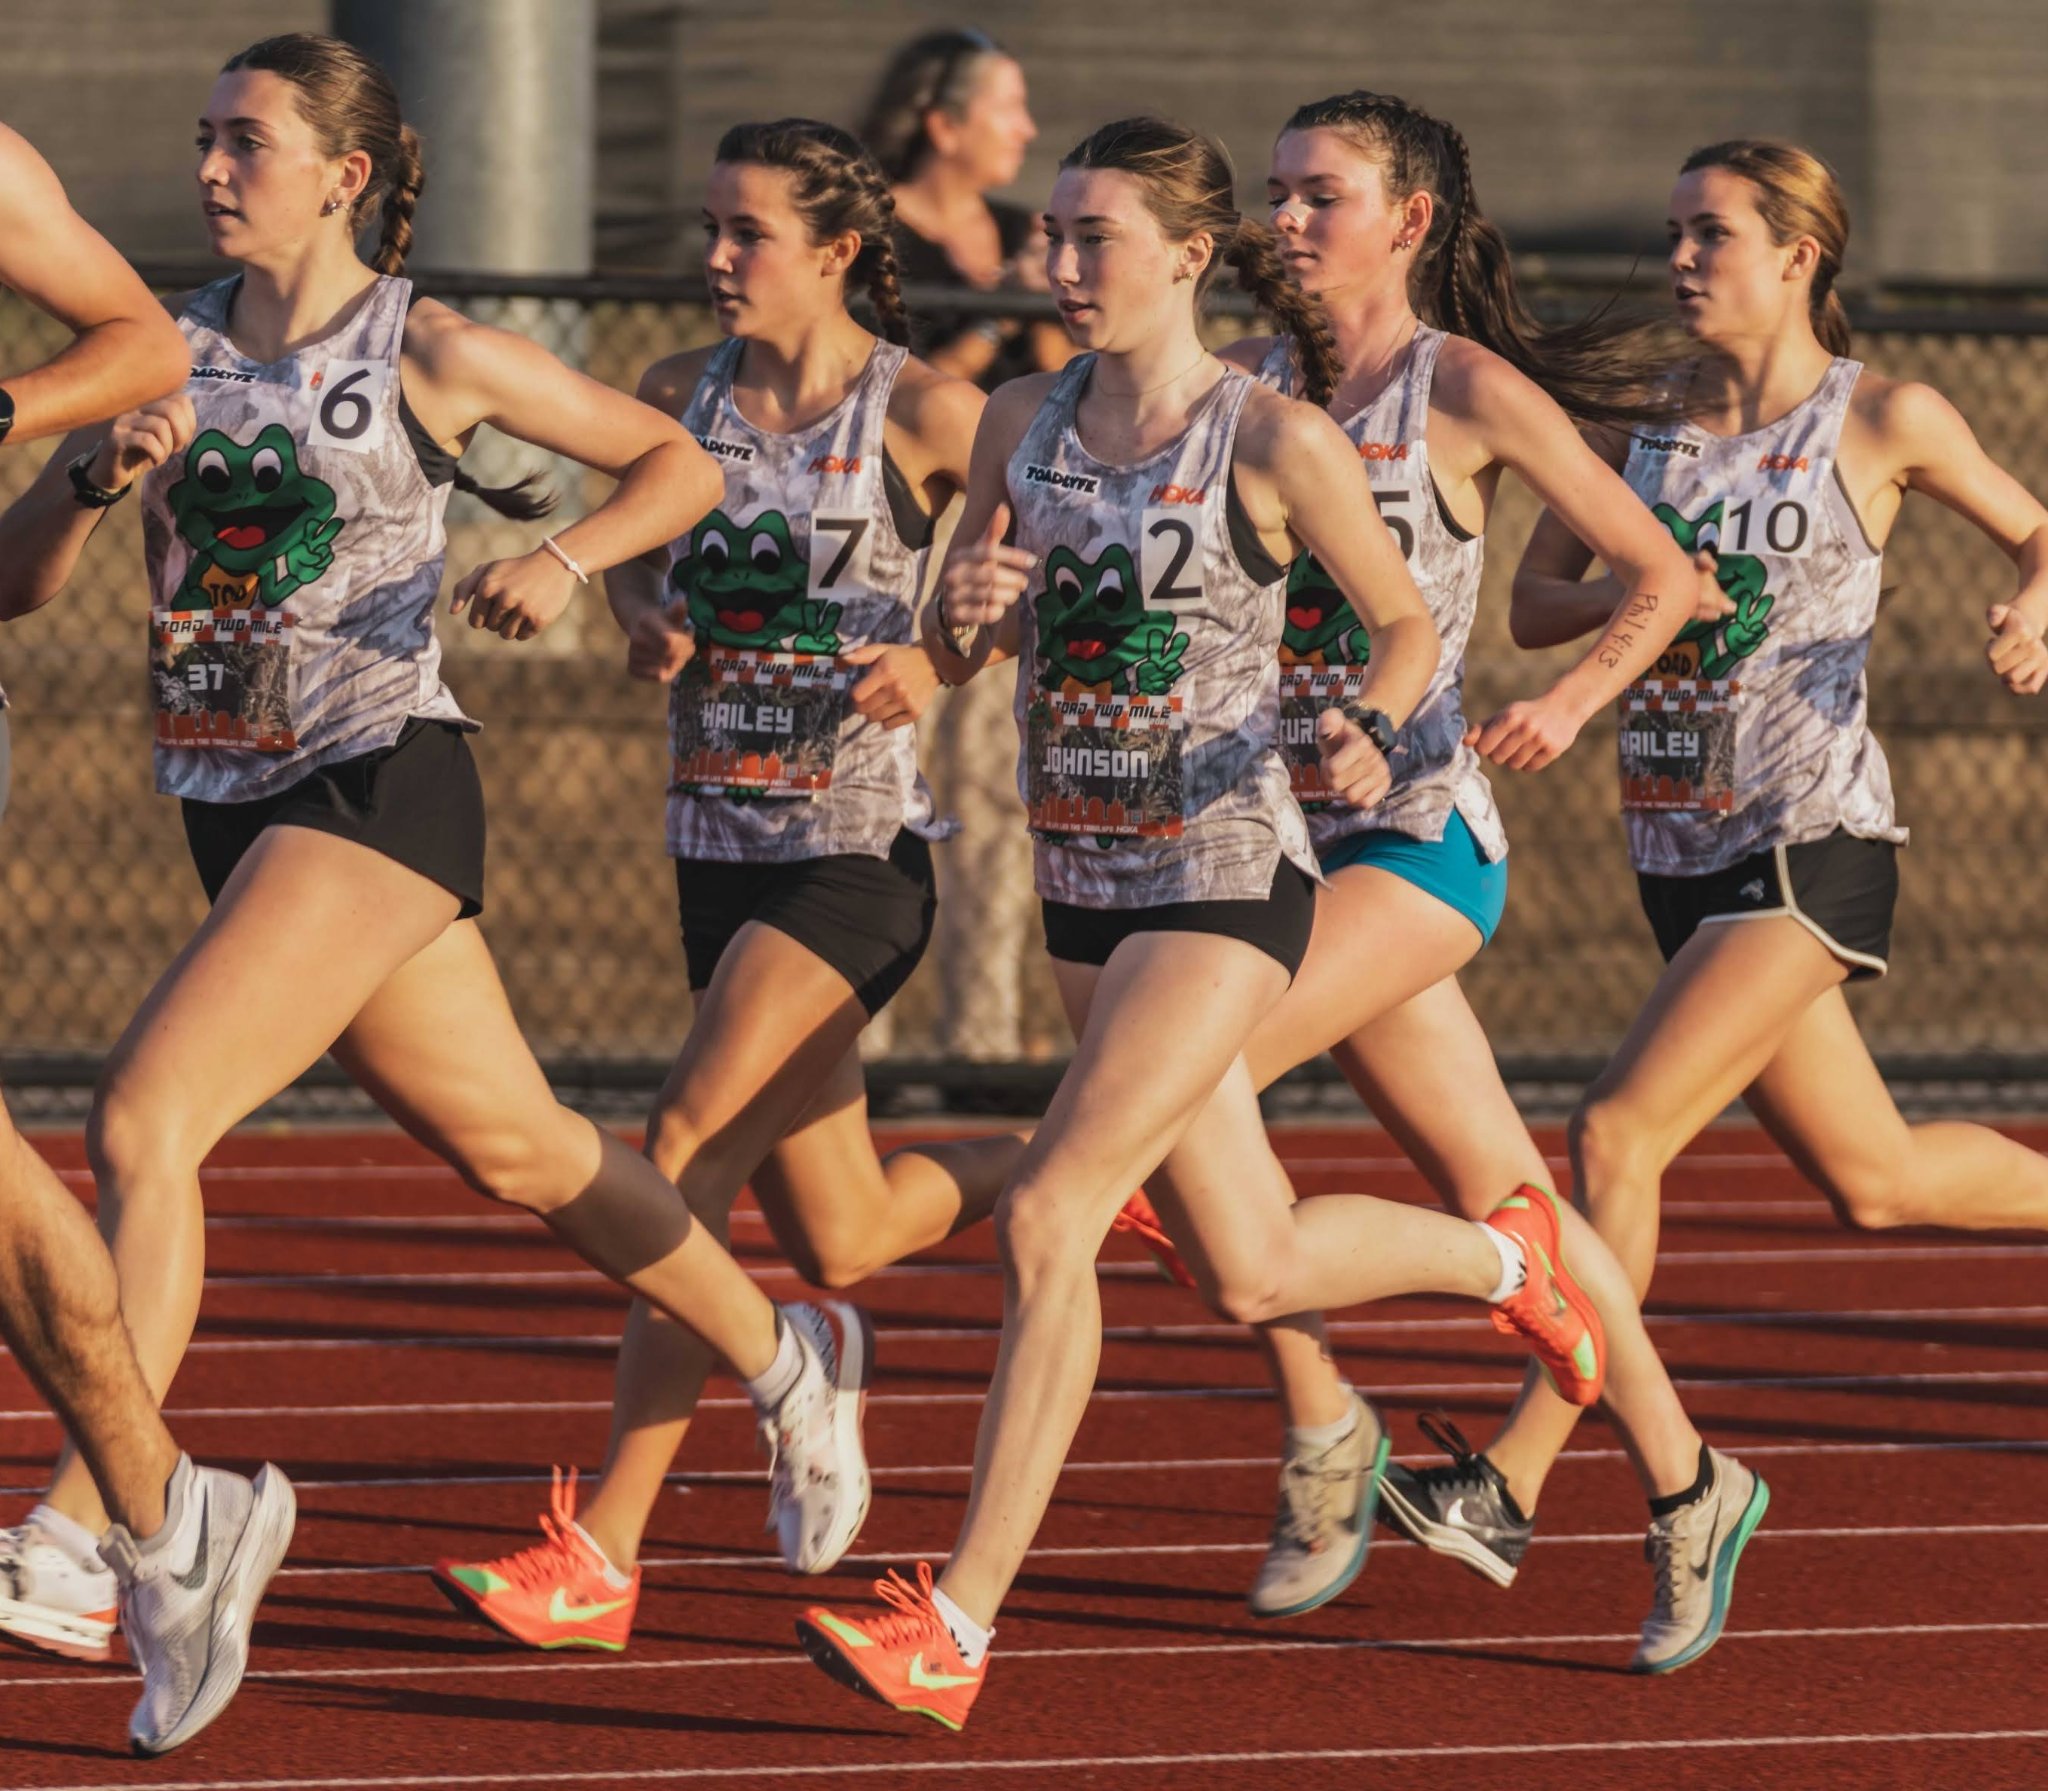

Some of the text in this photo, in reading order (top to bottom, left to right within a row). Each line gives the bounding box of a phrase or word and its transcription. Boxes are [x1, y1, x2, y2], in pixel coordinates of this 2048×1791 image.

[319, 367, 372, 440] 6
[1728, 498, 1809, 554] 10
[815, 518, 870, 589] 7
[1147, 517, 1203, 600] 2
[159, 619, 284, 635] TOAD TWO MILE
[187, 663, 225, 691] 37
[715, 658, 836, 680] TOAD TWO MILE
[1310, 674, 1341, 686] TWO
[1344, 674, 1364, 686] MI
[1055, 700, 1173, 719] TOAD TWO MILE
[1661, 689, 1691, 702] TWO
[1696, 689, 1731, 702] MILE
[702, 701, 794, 734] HAILEY
[1620, 730, 1699, 757] HAILEY
[1042, 745, 1149, 779] JOHNSON
